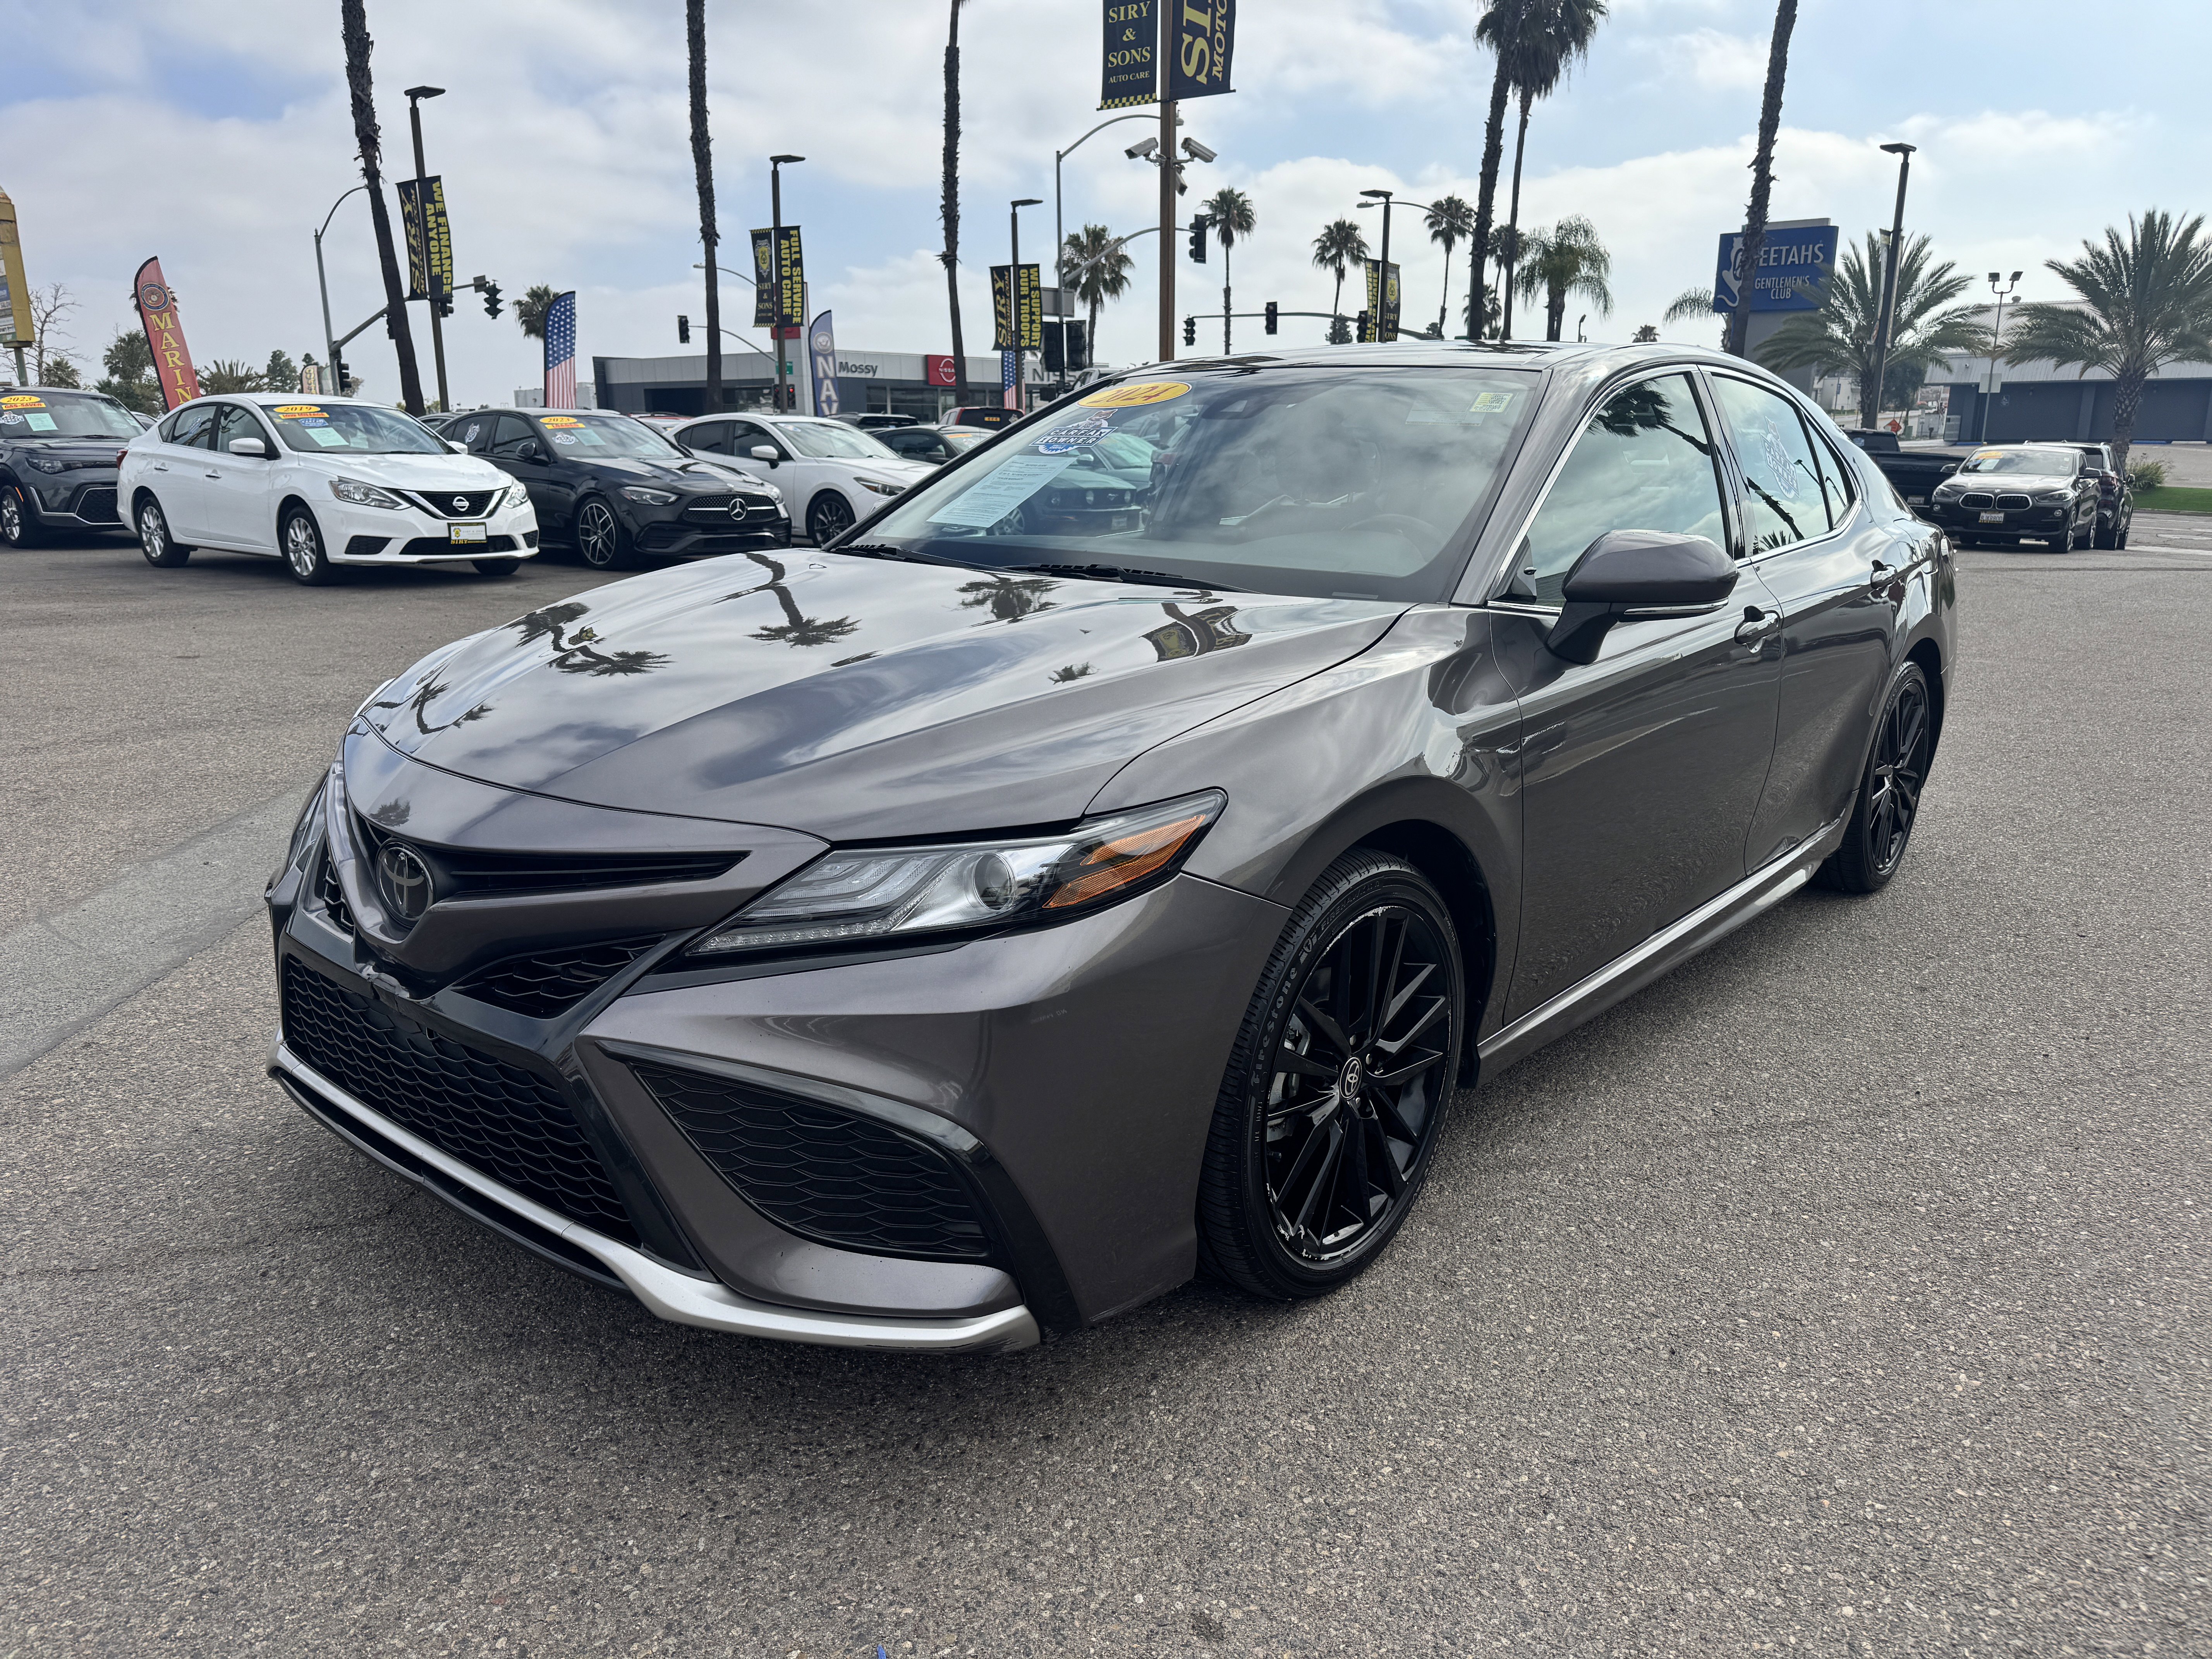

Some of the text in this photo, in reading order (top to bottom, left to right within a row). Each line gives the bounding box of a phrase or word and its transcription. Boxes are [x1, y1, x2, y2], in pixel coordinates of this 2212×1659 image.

[1109, 1, 1151, 23] SIRY
[1122, 28, 1136, 41] &
[1108, 46, 1151, 68] SONS
[1108, 71, 1150, 84] AUTO CARE
[426, 203, 441, 276] ANYONE
[433, 181, 452, 294] WE FINANCE
[1759, 244, 1824, 266] EETAHS
[758, 282, 772, 290] SIRY
[780, 239, 791, 315] AUTO CARE
[790, 230, 802, 324] FULL SERVICE
[1755, 275, 1810, 289] GENTLEMEN'S
[1771, 288, 1791, 299] CLUB
[993, 271, 1007, 347] SIRY
[1020, 269, 1030, 347] OUR TROOPS
[1029, 268, 1041, 347] WE SUPPORT
[1385, 331, 1396, 340] ONS
[149, 312, 192, 404] MARIN
[838, 362, 878, 377] Mossy
[1086, 385, 1179, 404] 2024
[1765, 443, 1795, 475] CARFAX
[1772, 461, 1797, 488] OWNER
[1250, 967, 1297, 1087] Firestone
